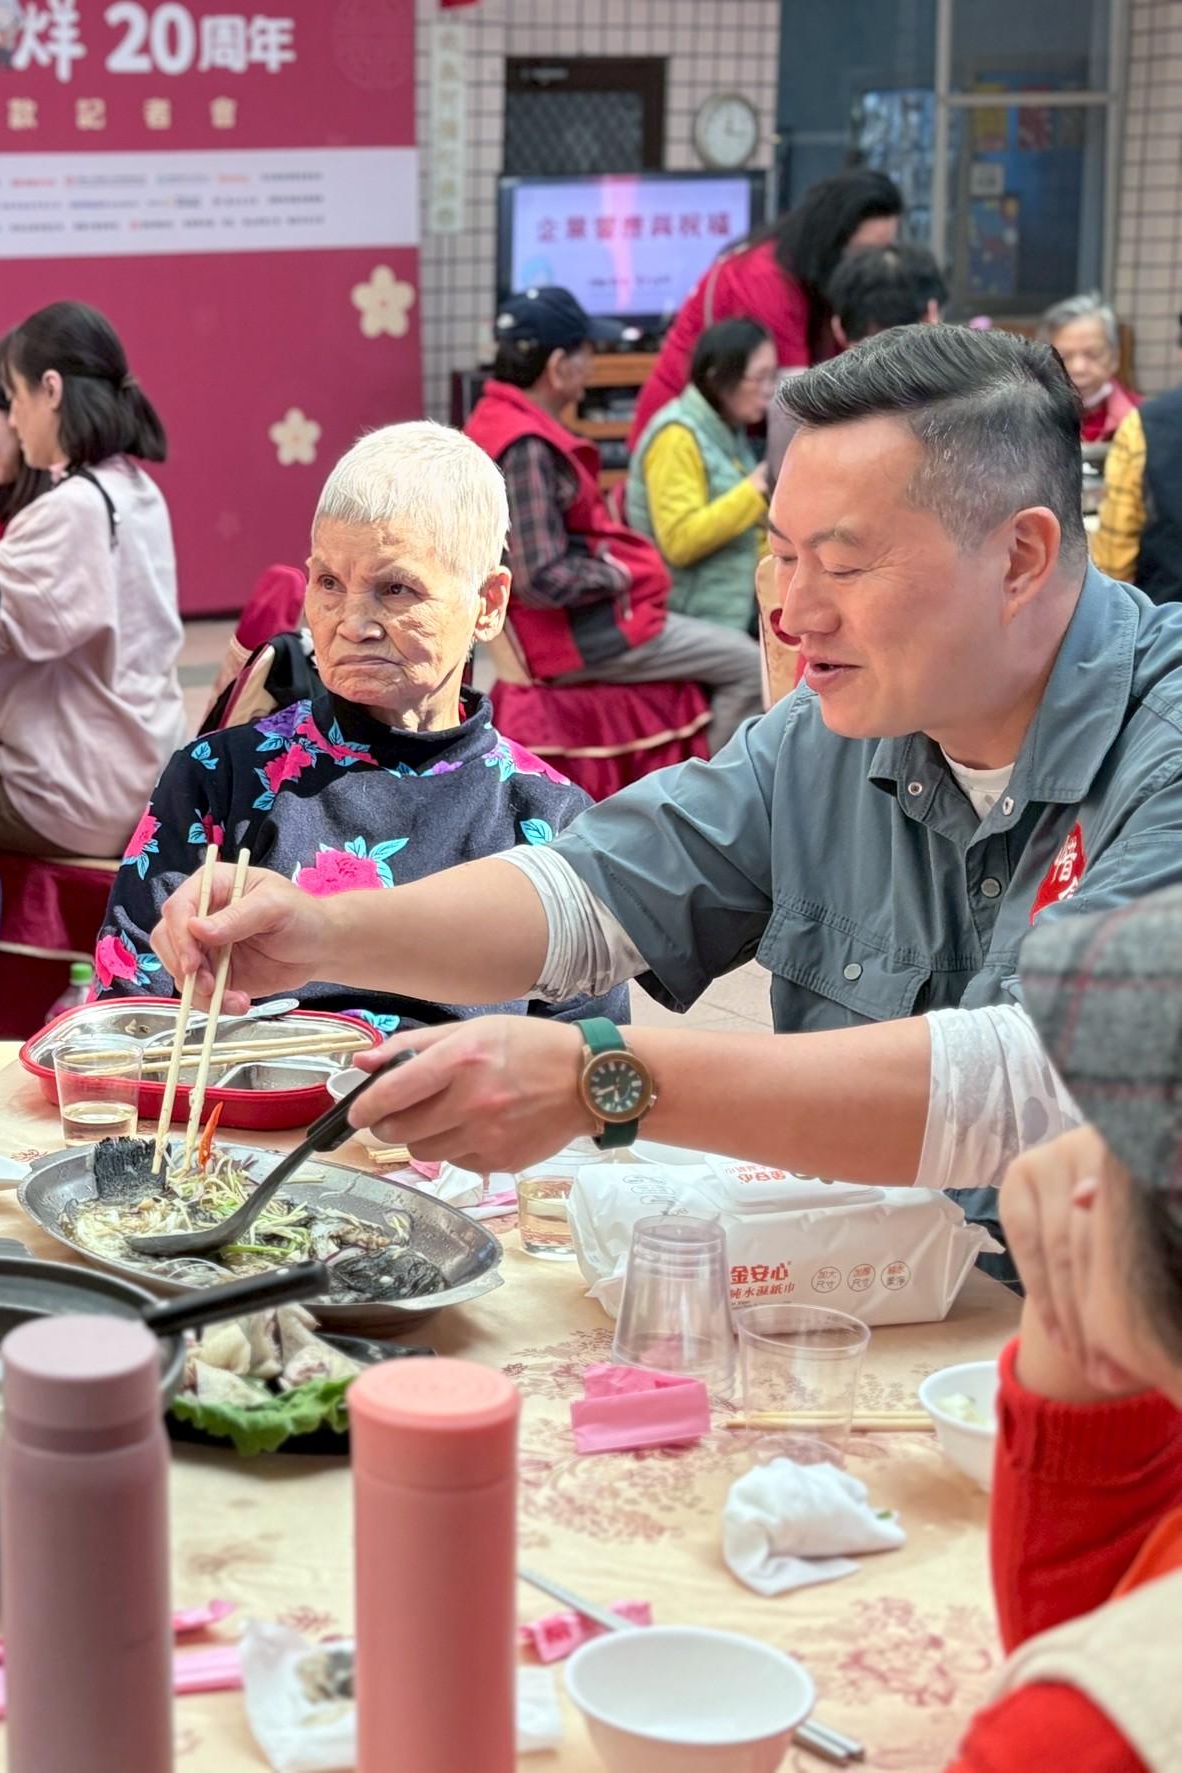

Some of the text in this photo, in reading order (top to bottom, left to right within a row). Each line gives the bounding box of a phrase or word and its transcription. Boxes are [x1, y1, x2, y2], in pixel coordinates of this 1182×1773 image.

[104, 1, 296, 75] 20周年
[729, 1262, 789, 1285] 金安心
